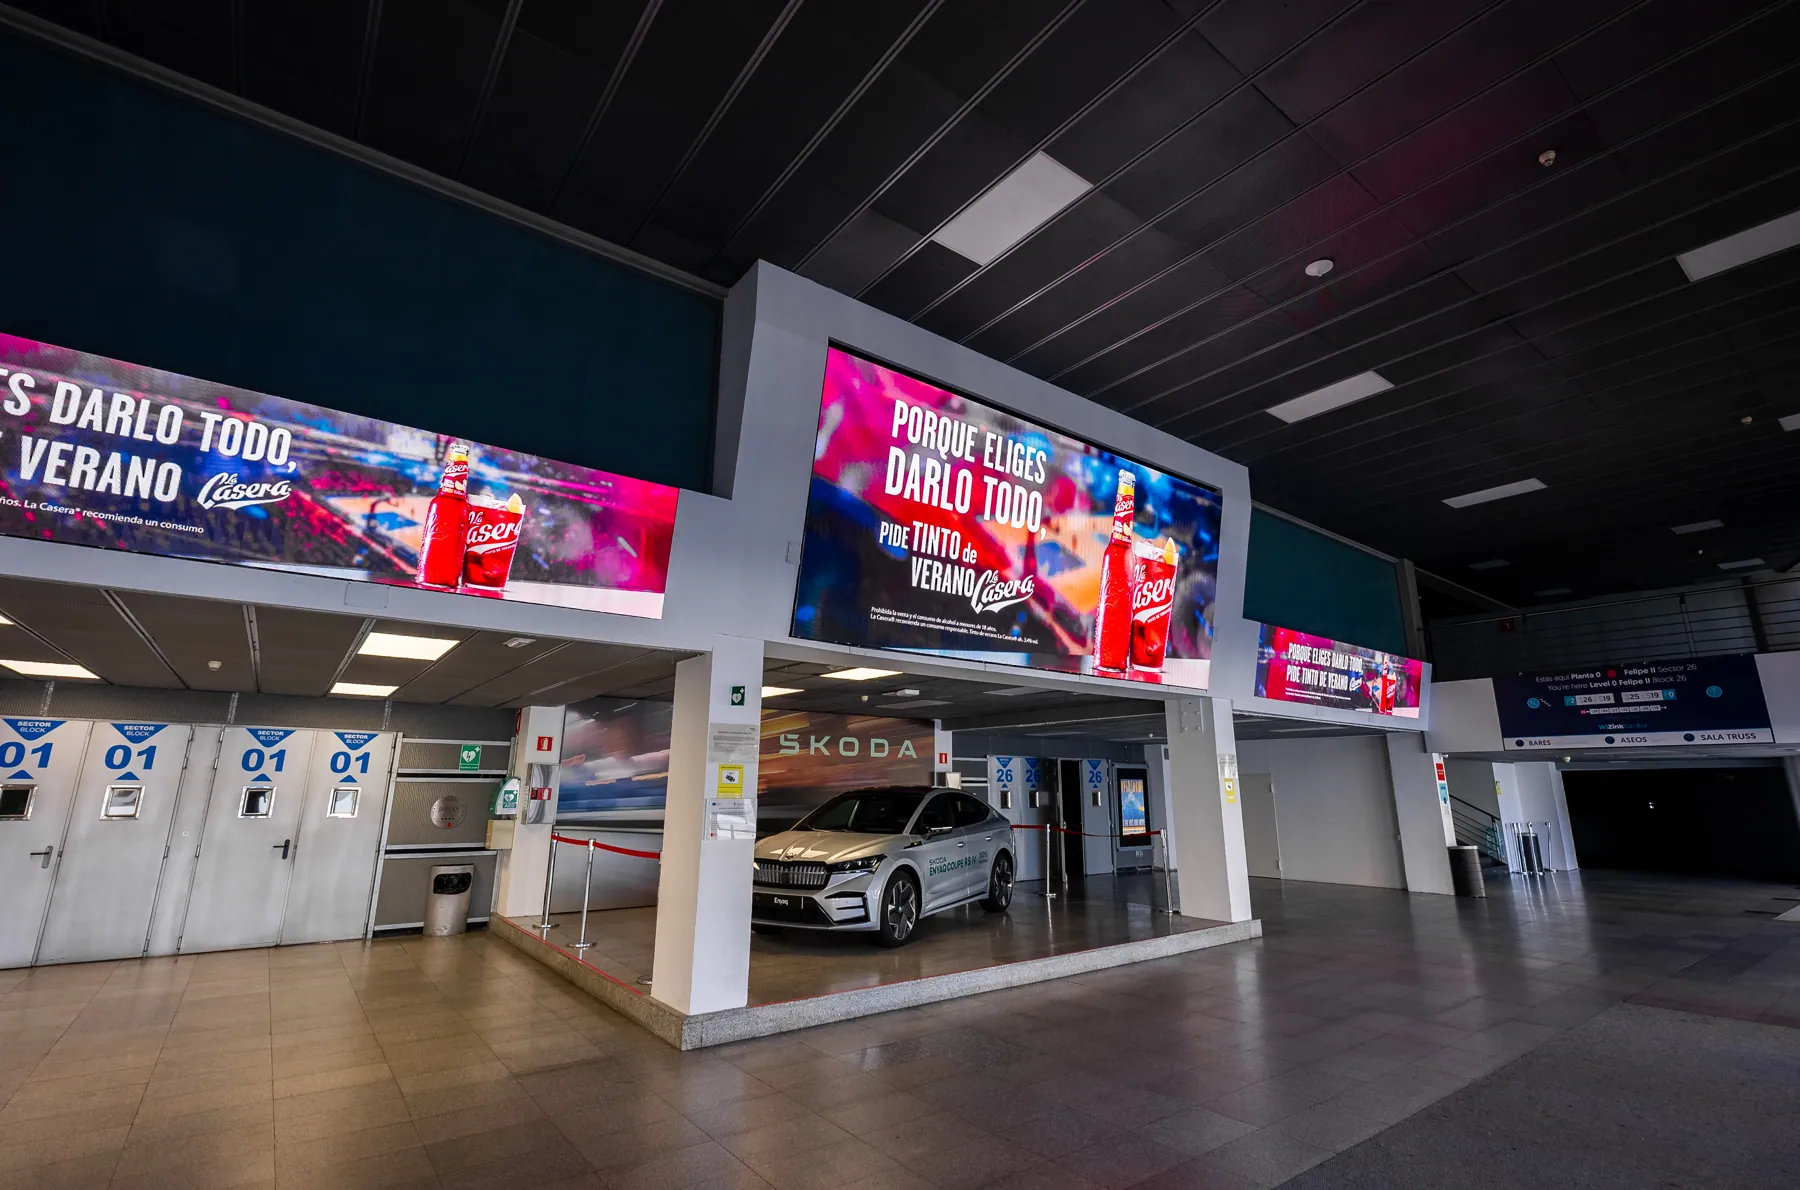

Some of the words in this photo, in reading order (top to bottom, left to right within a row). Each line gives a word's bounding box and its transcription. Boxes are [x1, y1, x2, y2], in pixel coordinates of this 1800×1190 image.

[49, 380, 184, 445] DARLO
[199, 411, 297, 473] TODO,
[891, 399, 978, 463] PORQUE
[983, 431, 1047, 484] ELIGES
[19, 435, 182, 502] VERANO
[196, 472, 292, 510] Casera
[884, 445, 973, 514] DARLO
[983, 475, 1047, 540] TODO,
[24, 500, 37, 509] La
[82, 507, 143, 525] recomienda
[145, 519, 159, 528] un
[159, 520, 205, 534] consumo
[878, 520, 911, 549] PIDE
[912, 520, 961, 560] TINTO
[962, 542, 978, 564] de
[911, 556, 976, 598] VERANO
[970, 569, 1036, 615] Casera
[871, 606, 893, 615] Prohibida
[1288, 642, 1312, 664] PORQUE
[1312, 648, 1332, 666] ELIGES
[1332, 652, 1349, 670] DARLO
[1286, 664, 1301, 683] PIDE
[1302, 667, 1319, 686] TINTO
[1320, 670, 1328, 688] DE
[1328, 672, 1349, 691] VERANO
[1536, 675, 1553, 683] Estás
[1571, 672, 1594, 680] Planta
[1624, 668, 1649, 676] Felipe
[1657, 664, 1685, 673] Sector
[1548, 682, 1570, 691] You're
[1589, 680, 1610, 688] Level
[1619, 678, 1644, 687] Felipe
[1652, 675, 1674, 684] Block
[0, 741, 54, 769] 01
[104, 744, 157, 770] 01
[241, 748, 286, 772] 01
[330, 751, 370, 774] 01
[996, 768, 1014, 782] 26
[1026, 769, 1040, 783] 26
[1088, 770, 1102, 784] 26
[930, 862, 946, 876] ENYAQ
[964, 856, 972, 867] RS
[774, 896, 788, 906] Enyaq
